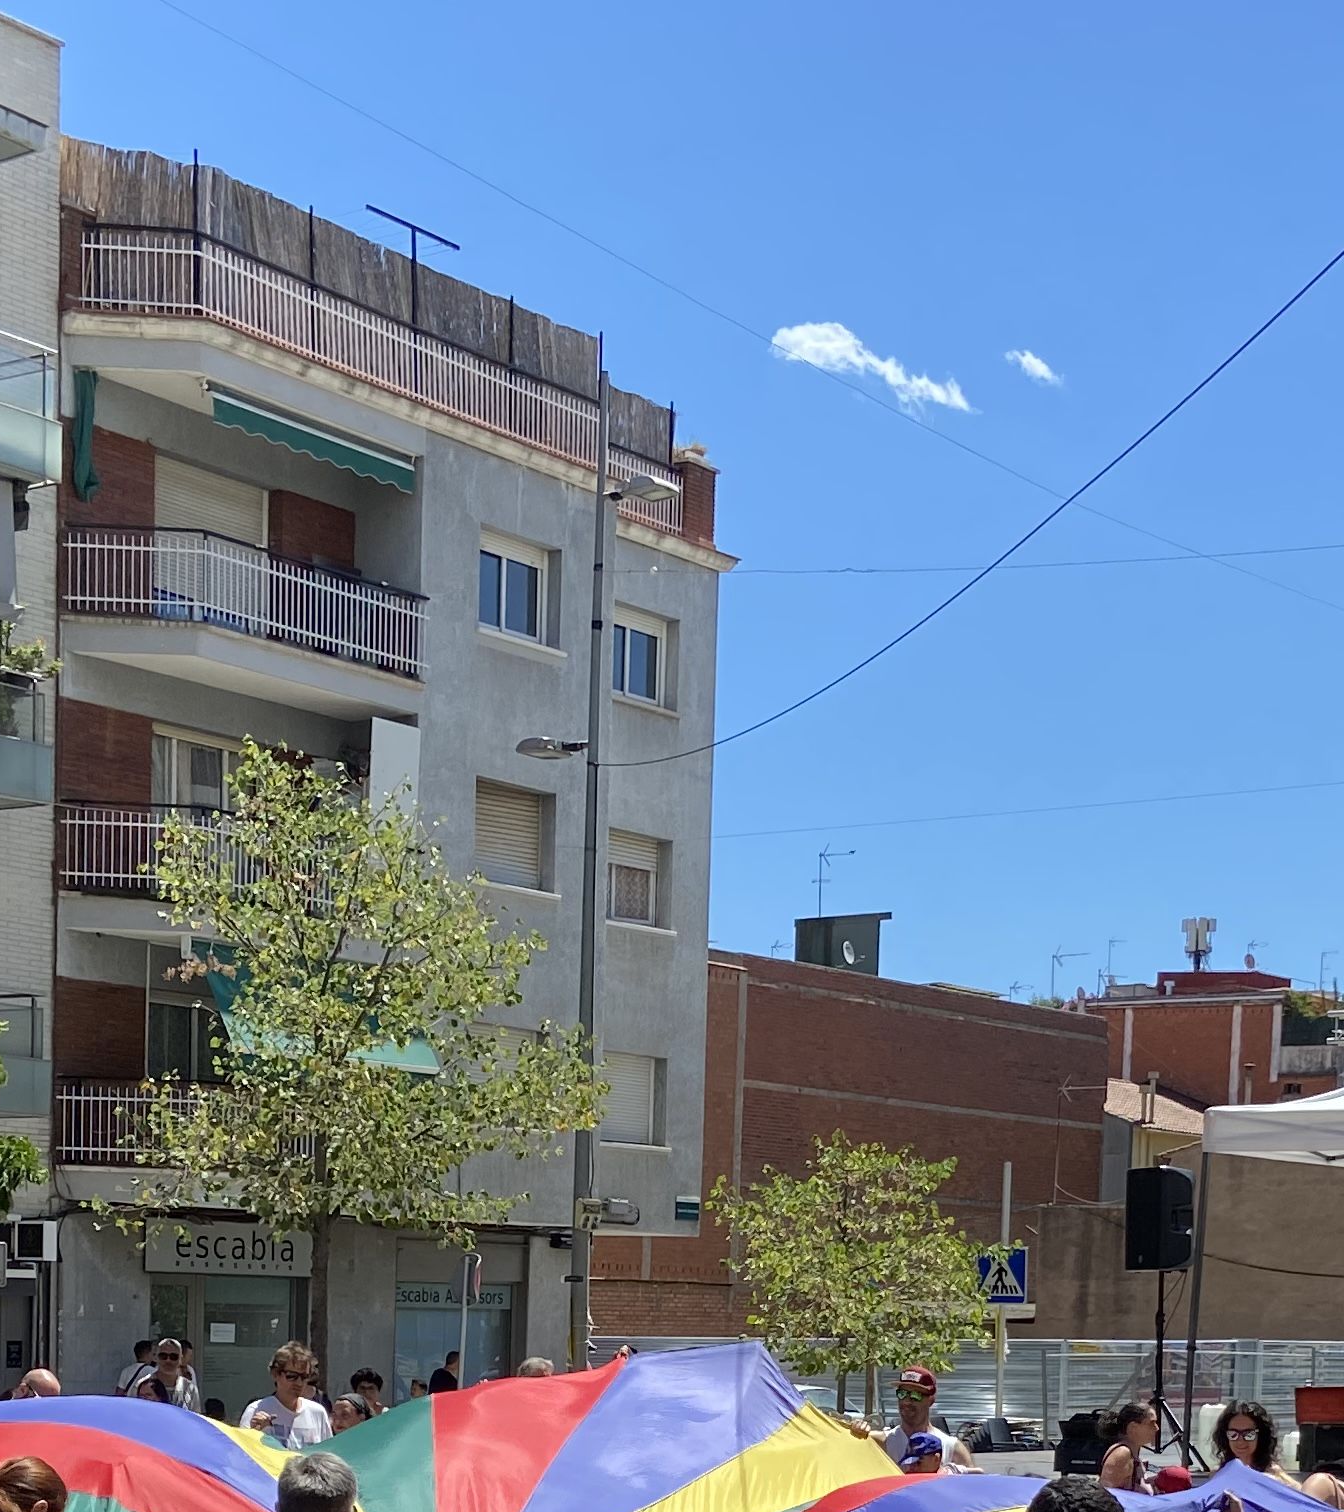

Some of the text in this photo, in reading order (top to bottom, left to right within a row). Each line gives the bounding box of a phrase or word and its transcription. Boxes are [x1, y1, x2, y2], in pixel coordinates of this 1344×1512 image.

[175, 1230, 294, 1263] escabia
[175, 1260, 293, 1271] assessors
[395, 1286, 504, 1304] Escabia Asors
